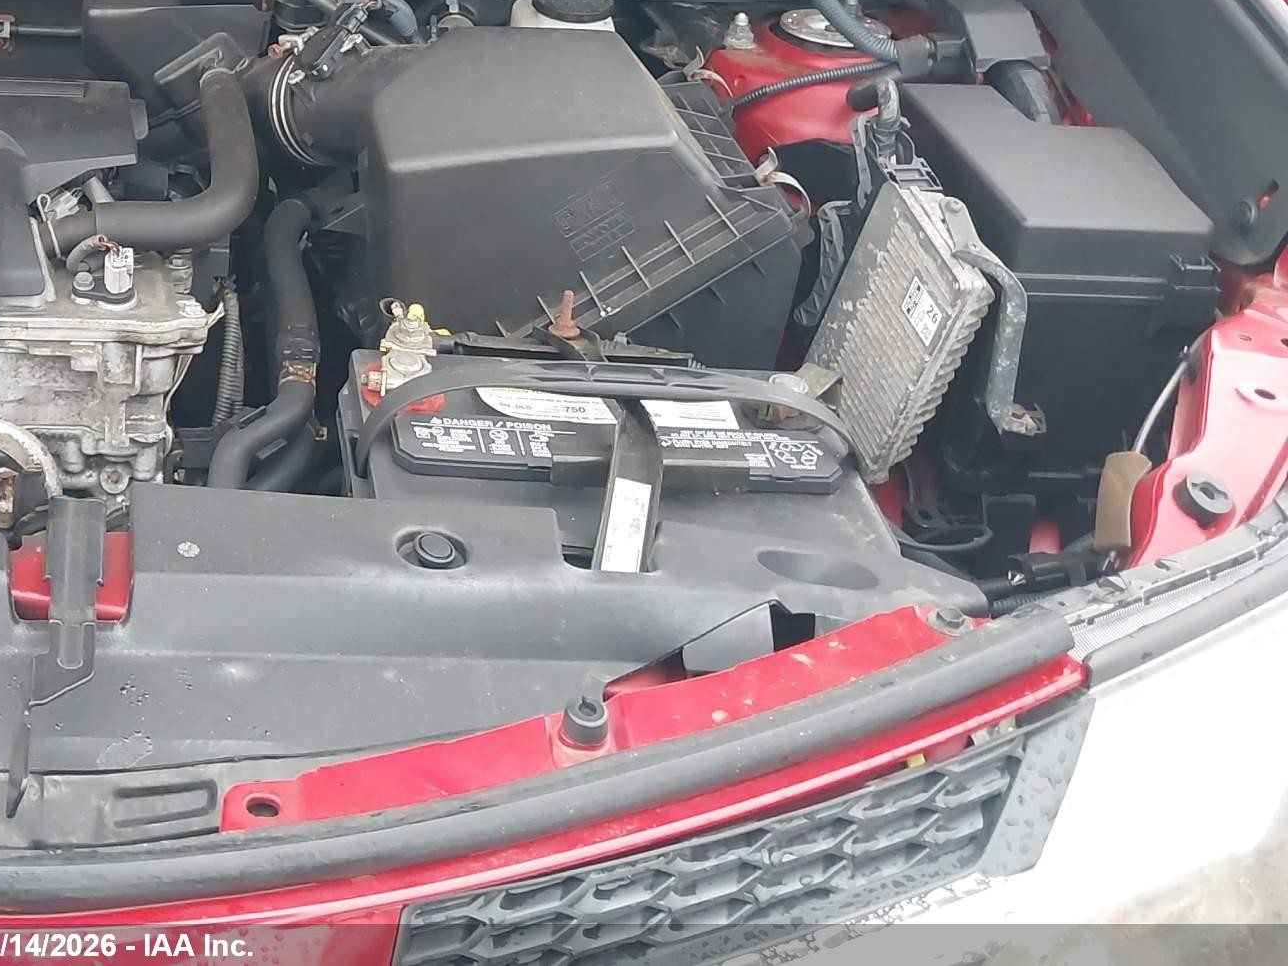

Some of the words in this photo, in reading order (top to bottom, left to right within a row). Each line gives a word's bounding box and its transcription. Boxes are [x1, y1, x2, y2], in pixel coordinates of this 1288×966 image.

[564, 405, 586, 414] 750
[443, 417, 493, 428] DANGER
[506, 421, 552, 431] POISON
